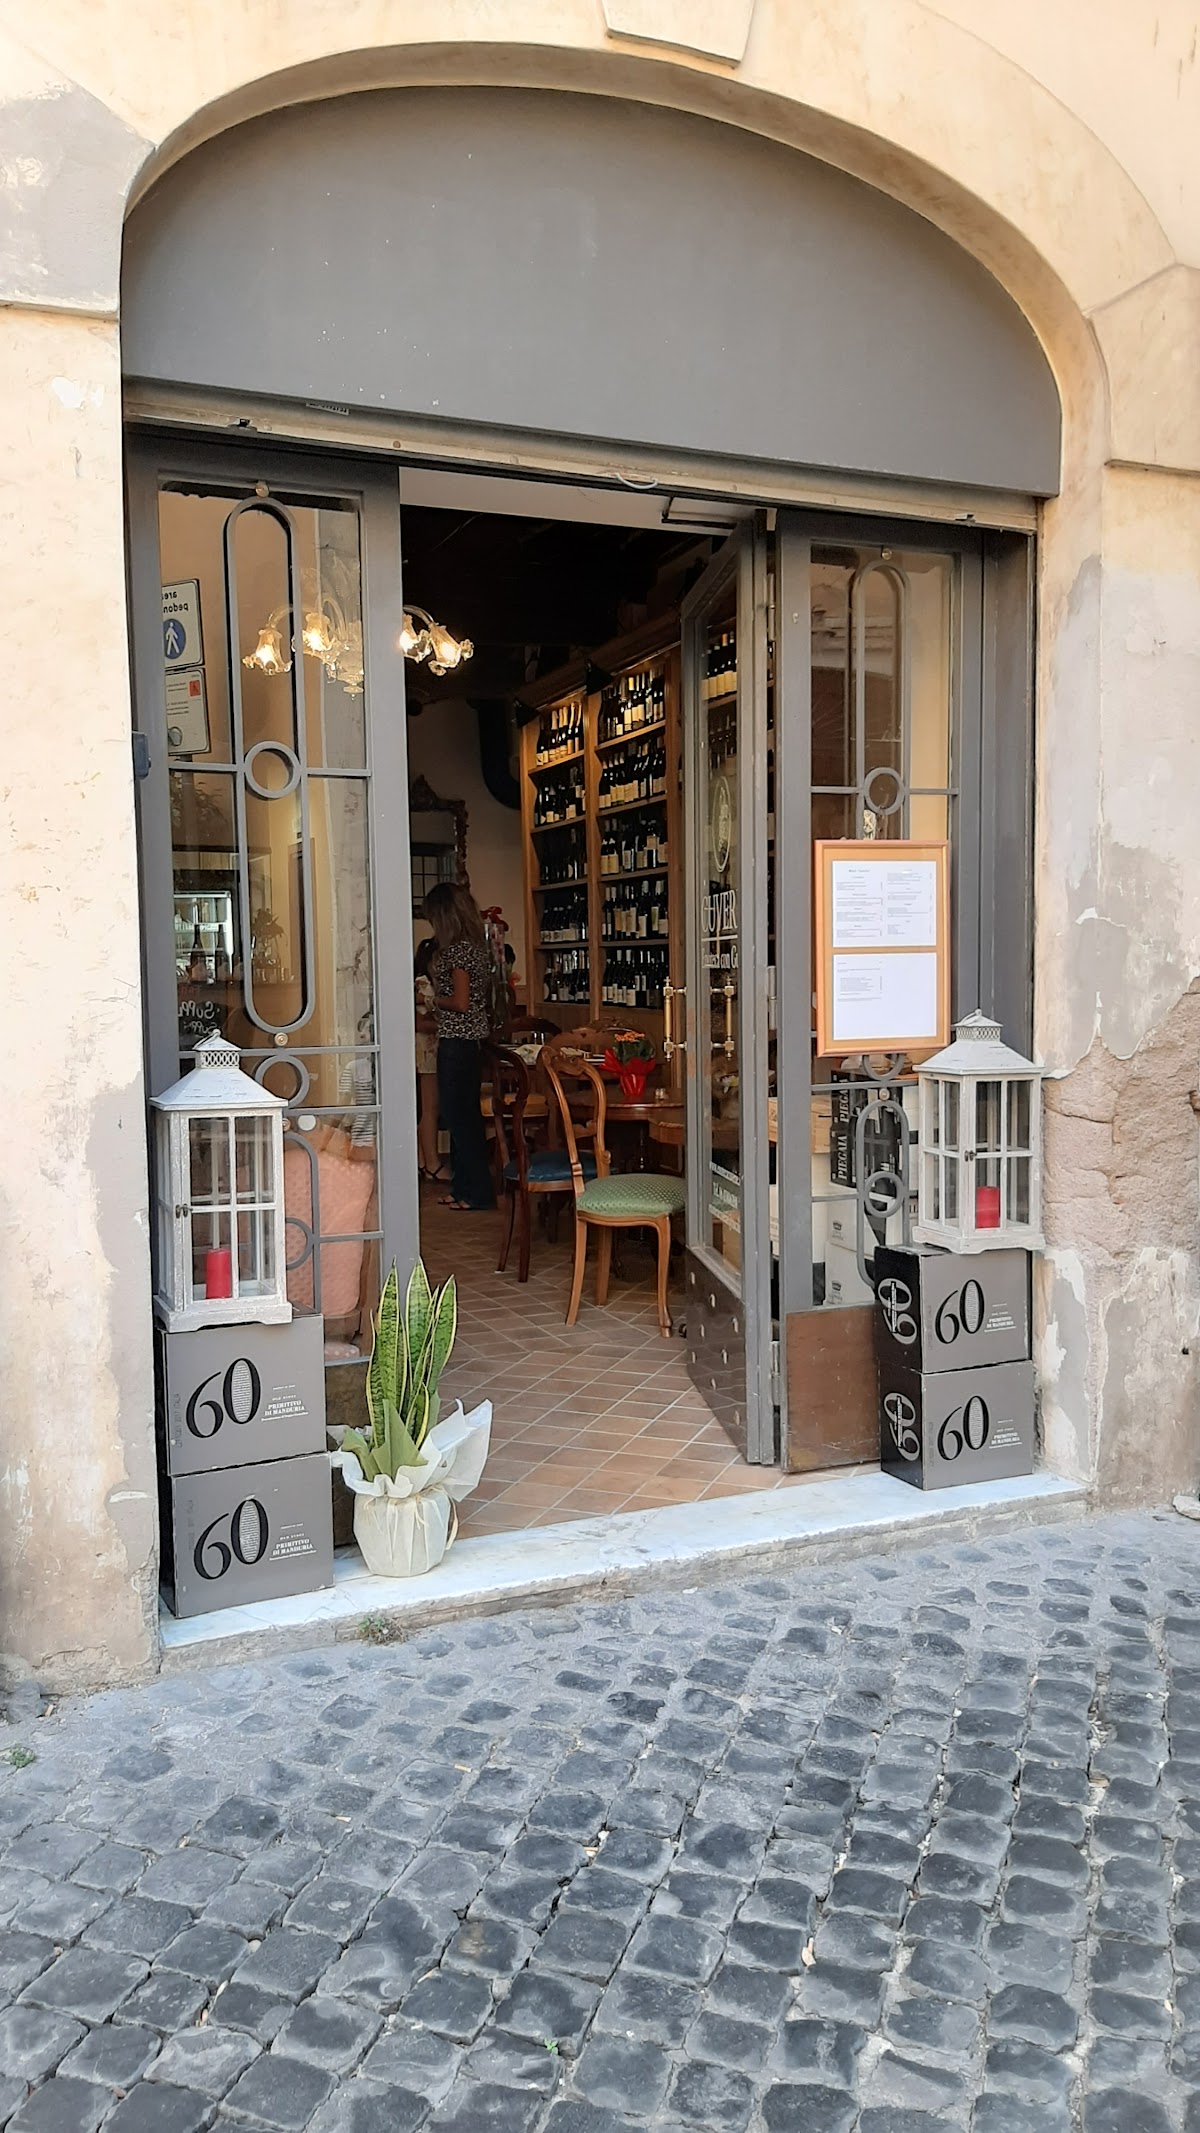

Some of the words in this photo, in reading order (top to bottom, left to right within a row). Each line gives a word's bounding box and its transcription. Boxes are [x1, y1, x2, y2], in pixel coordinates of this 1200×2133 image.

[839, 1078, 849, 1124] PIEGAA
[837, 1135, 848, 1180] PIEGAIA
[878, 1277, 918, 1345] 60
[935, 1279, 985, 1345] 60
[185, 1357, 261, 1438] 60
[268, 1400, 302, 1409] PRIMITIVO
[273, 1406, 305, 1415] MANDURIA
[883, 1392, 920, 1461] 60
[937, 1395, 989, 1461] 60
[194, 1497, 269, 1580] 60
[276, 1538, 310, 1549] PRIMITIVO
[281, 1543, 314, 1554] MANDURIA
